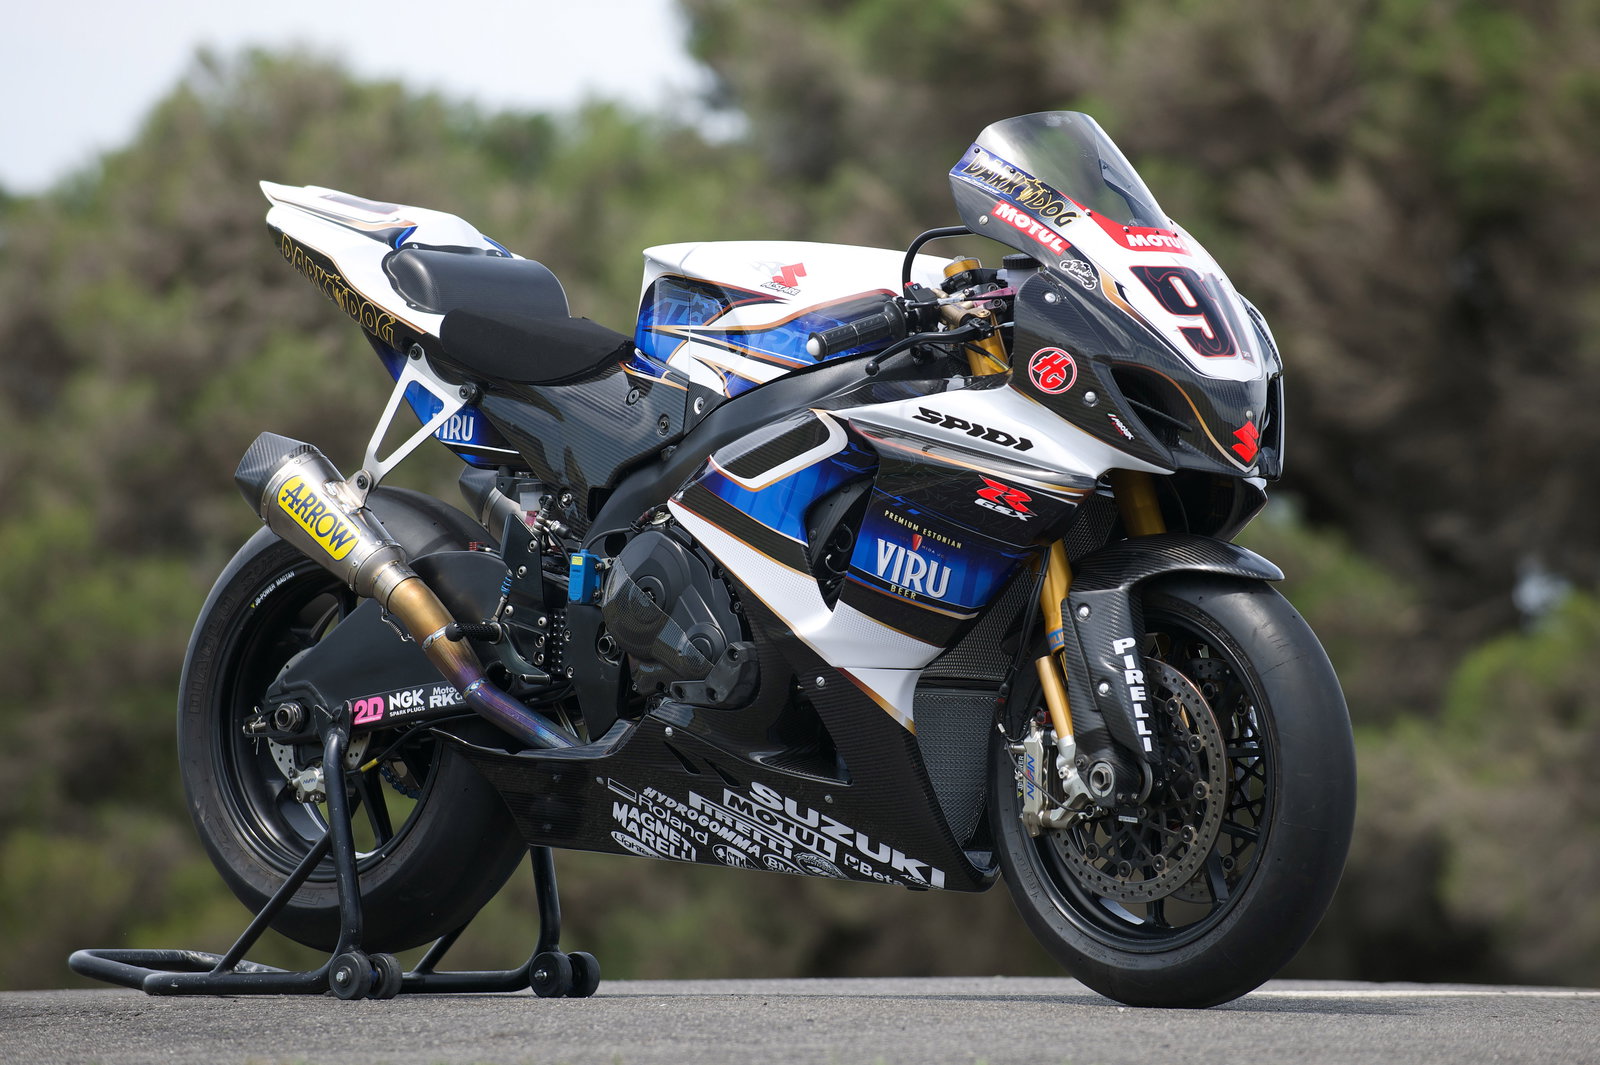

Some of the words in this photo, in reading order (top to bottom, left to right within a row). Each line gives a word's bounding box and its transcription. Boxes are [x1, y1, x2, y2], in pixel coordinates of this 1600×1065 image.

[995, 203, 1067, 252] MOTUL
[1023, 189, 1078, 228] DOG
[912, 406, 1034, 451] SPIDI
[281, 482, 356, 552] ARROW
[884, 509, 919, 531] PREMIUM
[922, 528, 962, 549] ESTONIAN
[974, 498, 1032, 521] GSX
[877, 537, 952, 598] VIRU
[890, 584, 917, 600] BEER
[388, 688, 425, 710] NGK
[389, 709, 407, 717] SPARK
[407, 706, 425, 714] PLUGS
[429, 693, 456, 708] RK
[1112, 637, 1153, 752] PIRELLI
[613, 801, 697, 852] MAGNETI
[638, 793, 709, 845] Roland
[643, 786, 760, 858] HYDROGOMMA
[689, 790, 793, 860] PIRELLI
[723, 788, 838, 863] MOTUL
[749, 781, 945, 890] SUZUKI
